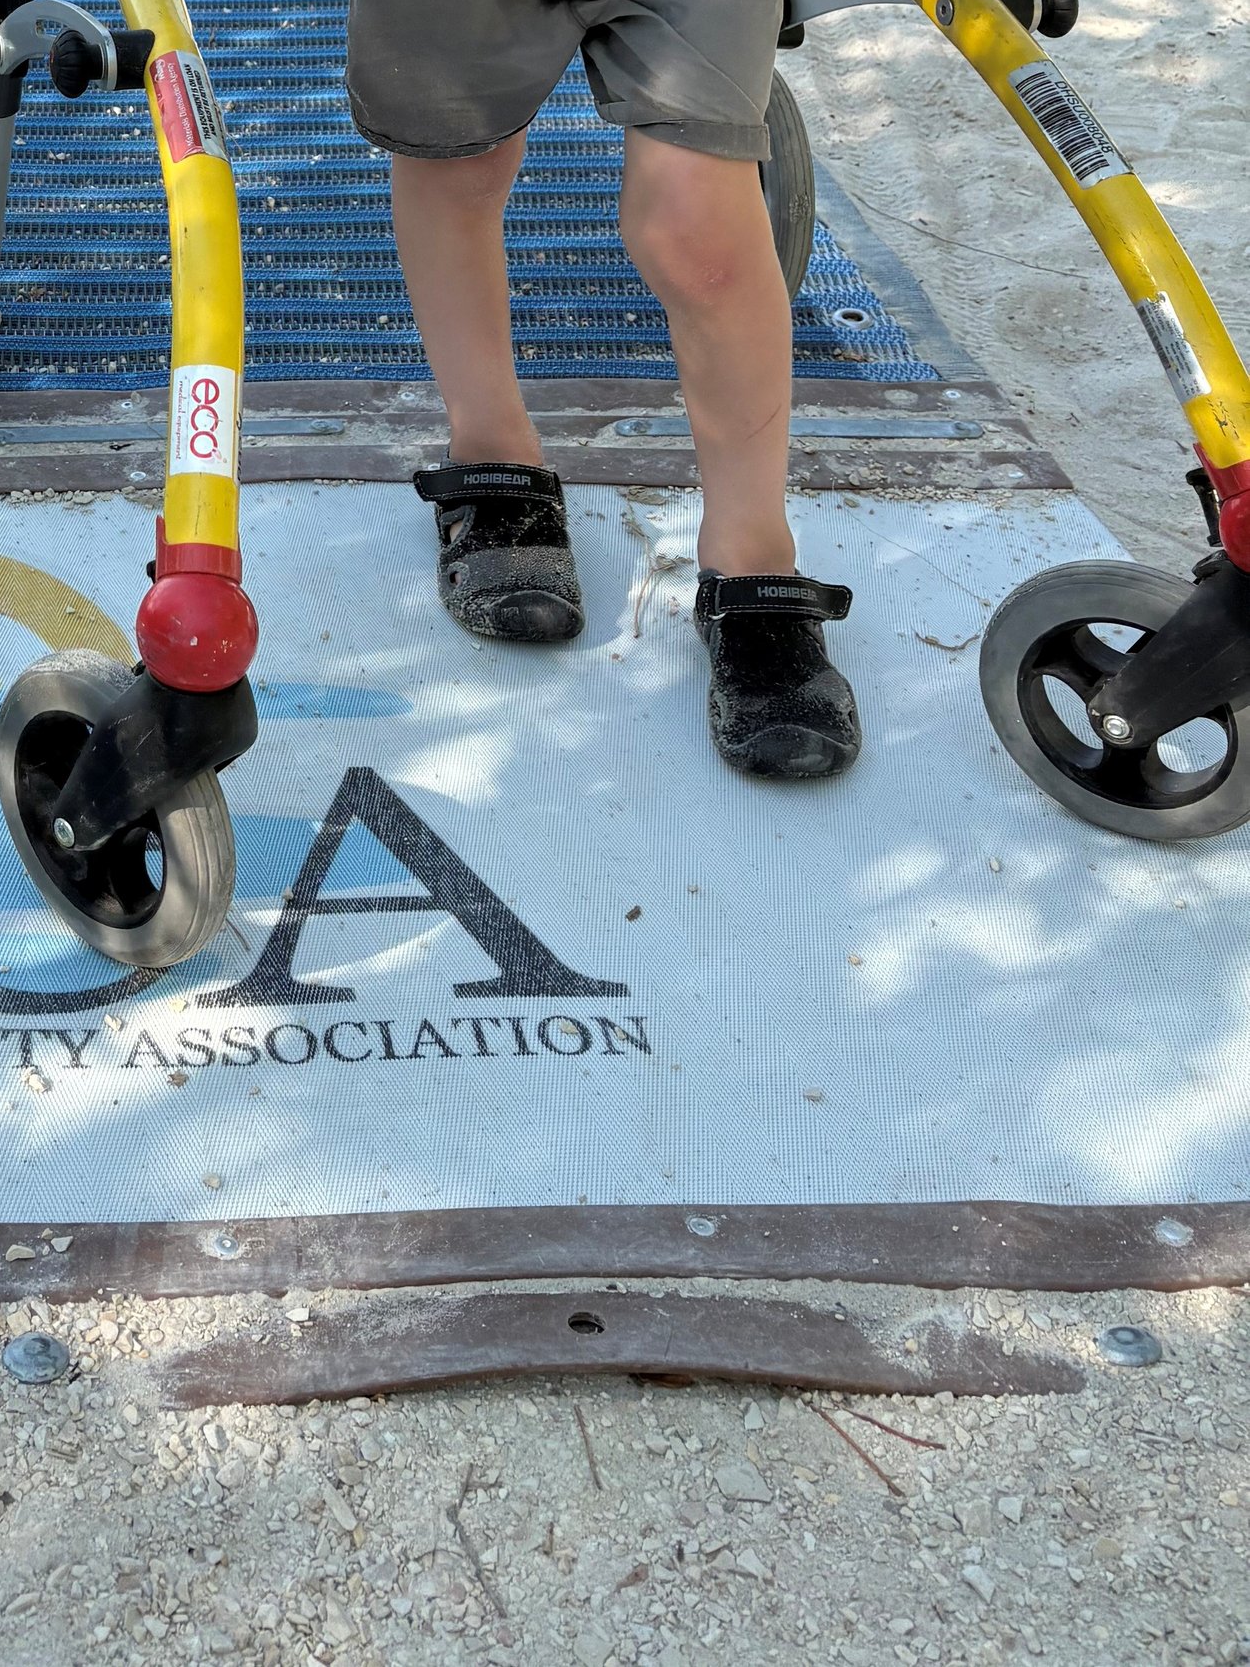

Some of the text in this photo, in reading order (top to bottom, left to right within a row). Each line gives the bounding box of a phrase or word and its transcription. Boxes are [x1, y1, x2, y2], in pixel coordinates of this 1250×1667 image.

[1055, 81, 1114, 153] DHSU008048
[178, 380, 186, 414] medical
[190, 378, 220, 459] eco
[463, 472, 531, 487] HOBIBEAR
[120, 1015, 652, 1069] ASSOCIATION
